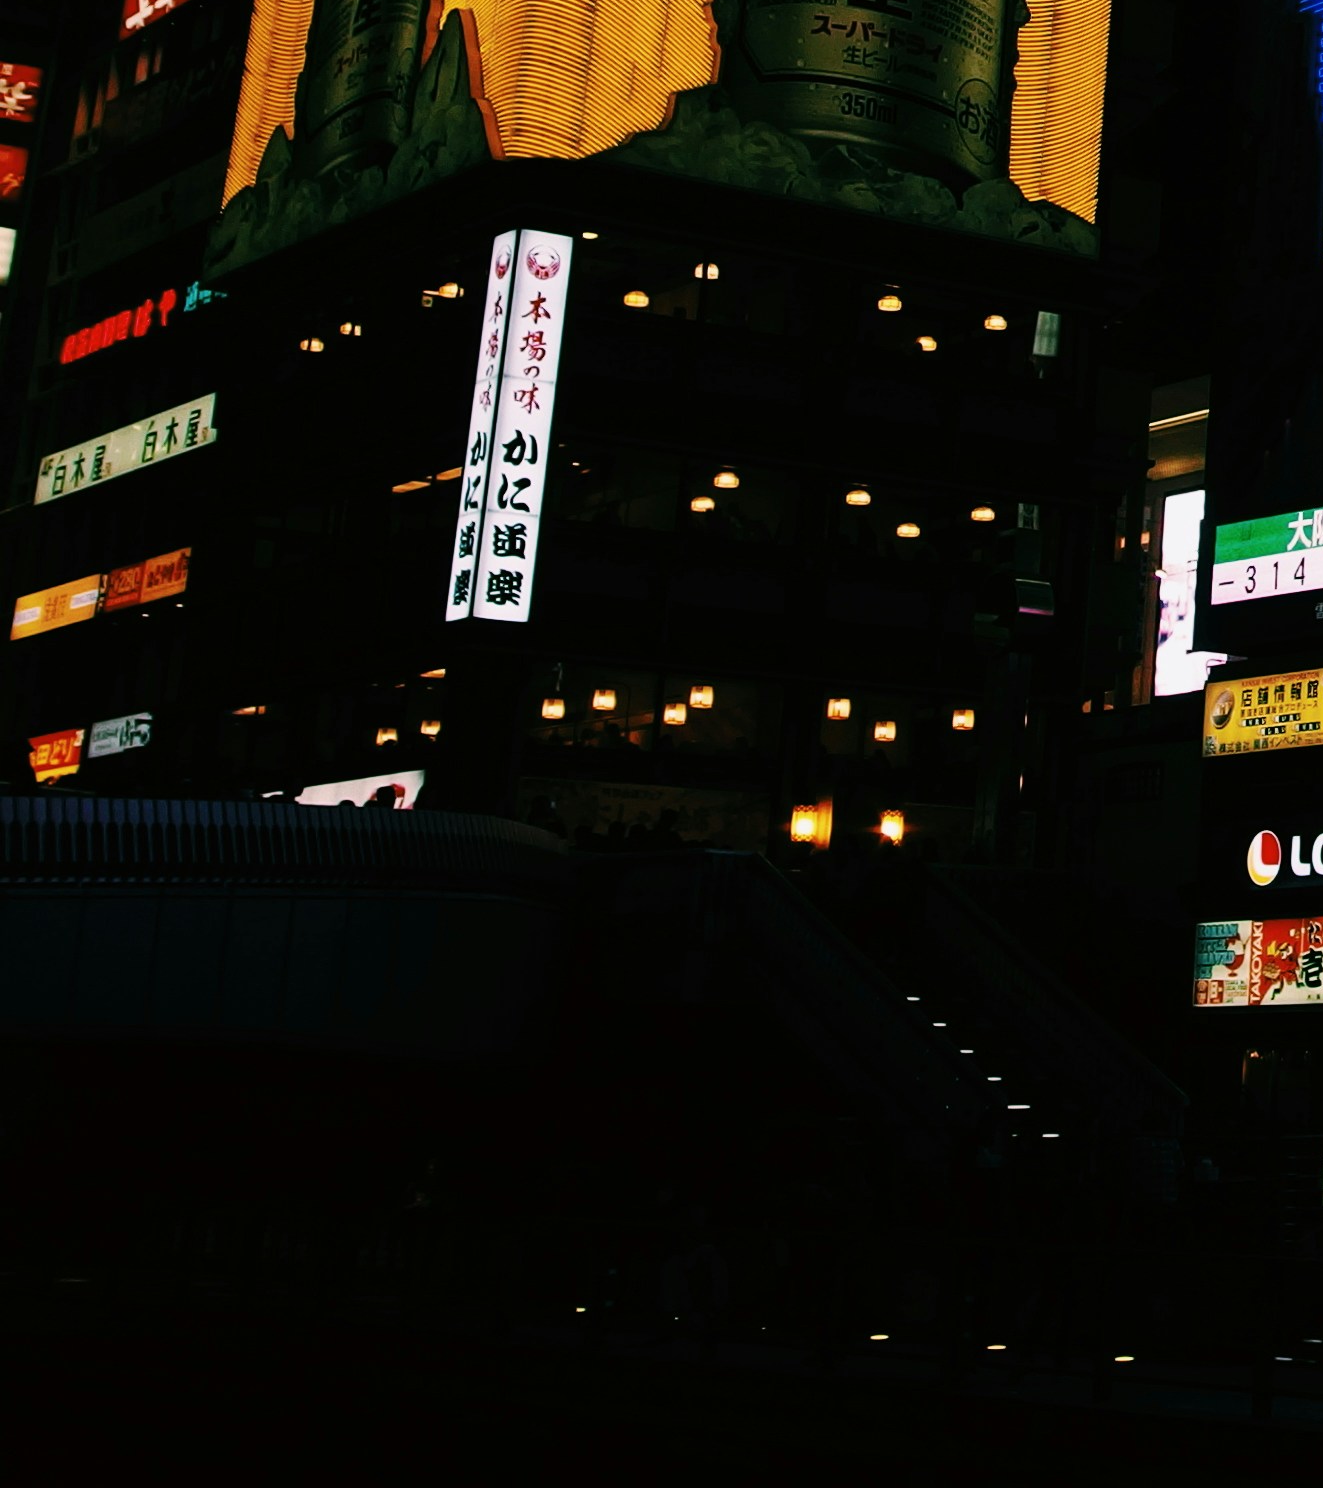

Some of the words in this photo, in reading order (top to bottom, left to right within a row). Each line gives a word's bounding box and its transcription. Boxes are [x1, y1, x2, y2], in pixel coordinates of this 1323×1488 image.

[513, 290, 552, 415] 本場の味
[51, 444, 107, 497] 白木屋
[140, 409, 202, 463] 白木屋
[1250, 921, 1264, 1002] TAKOYAKI
